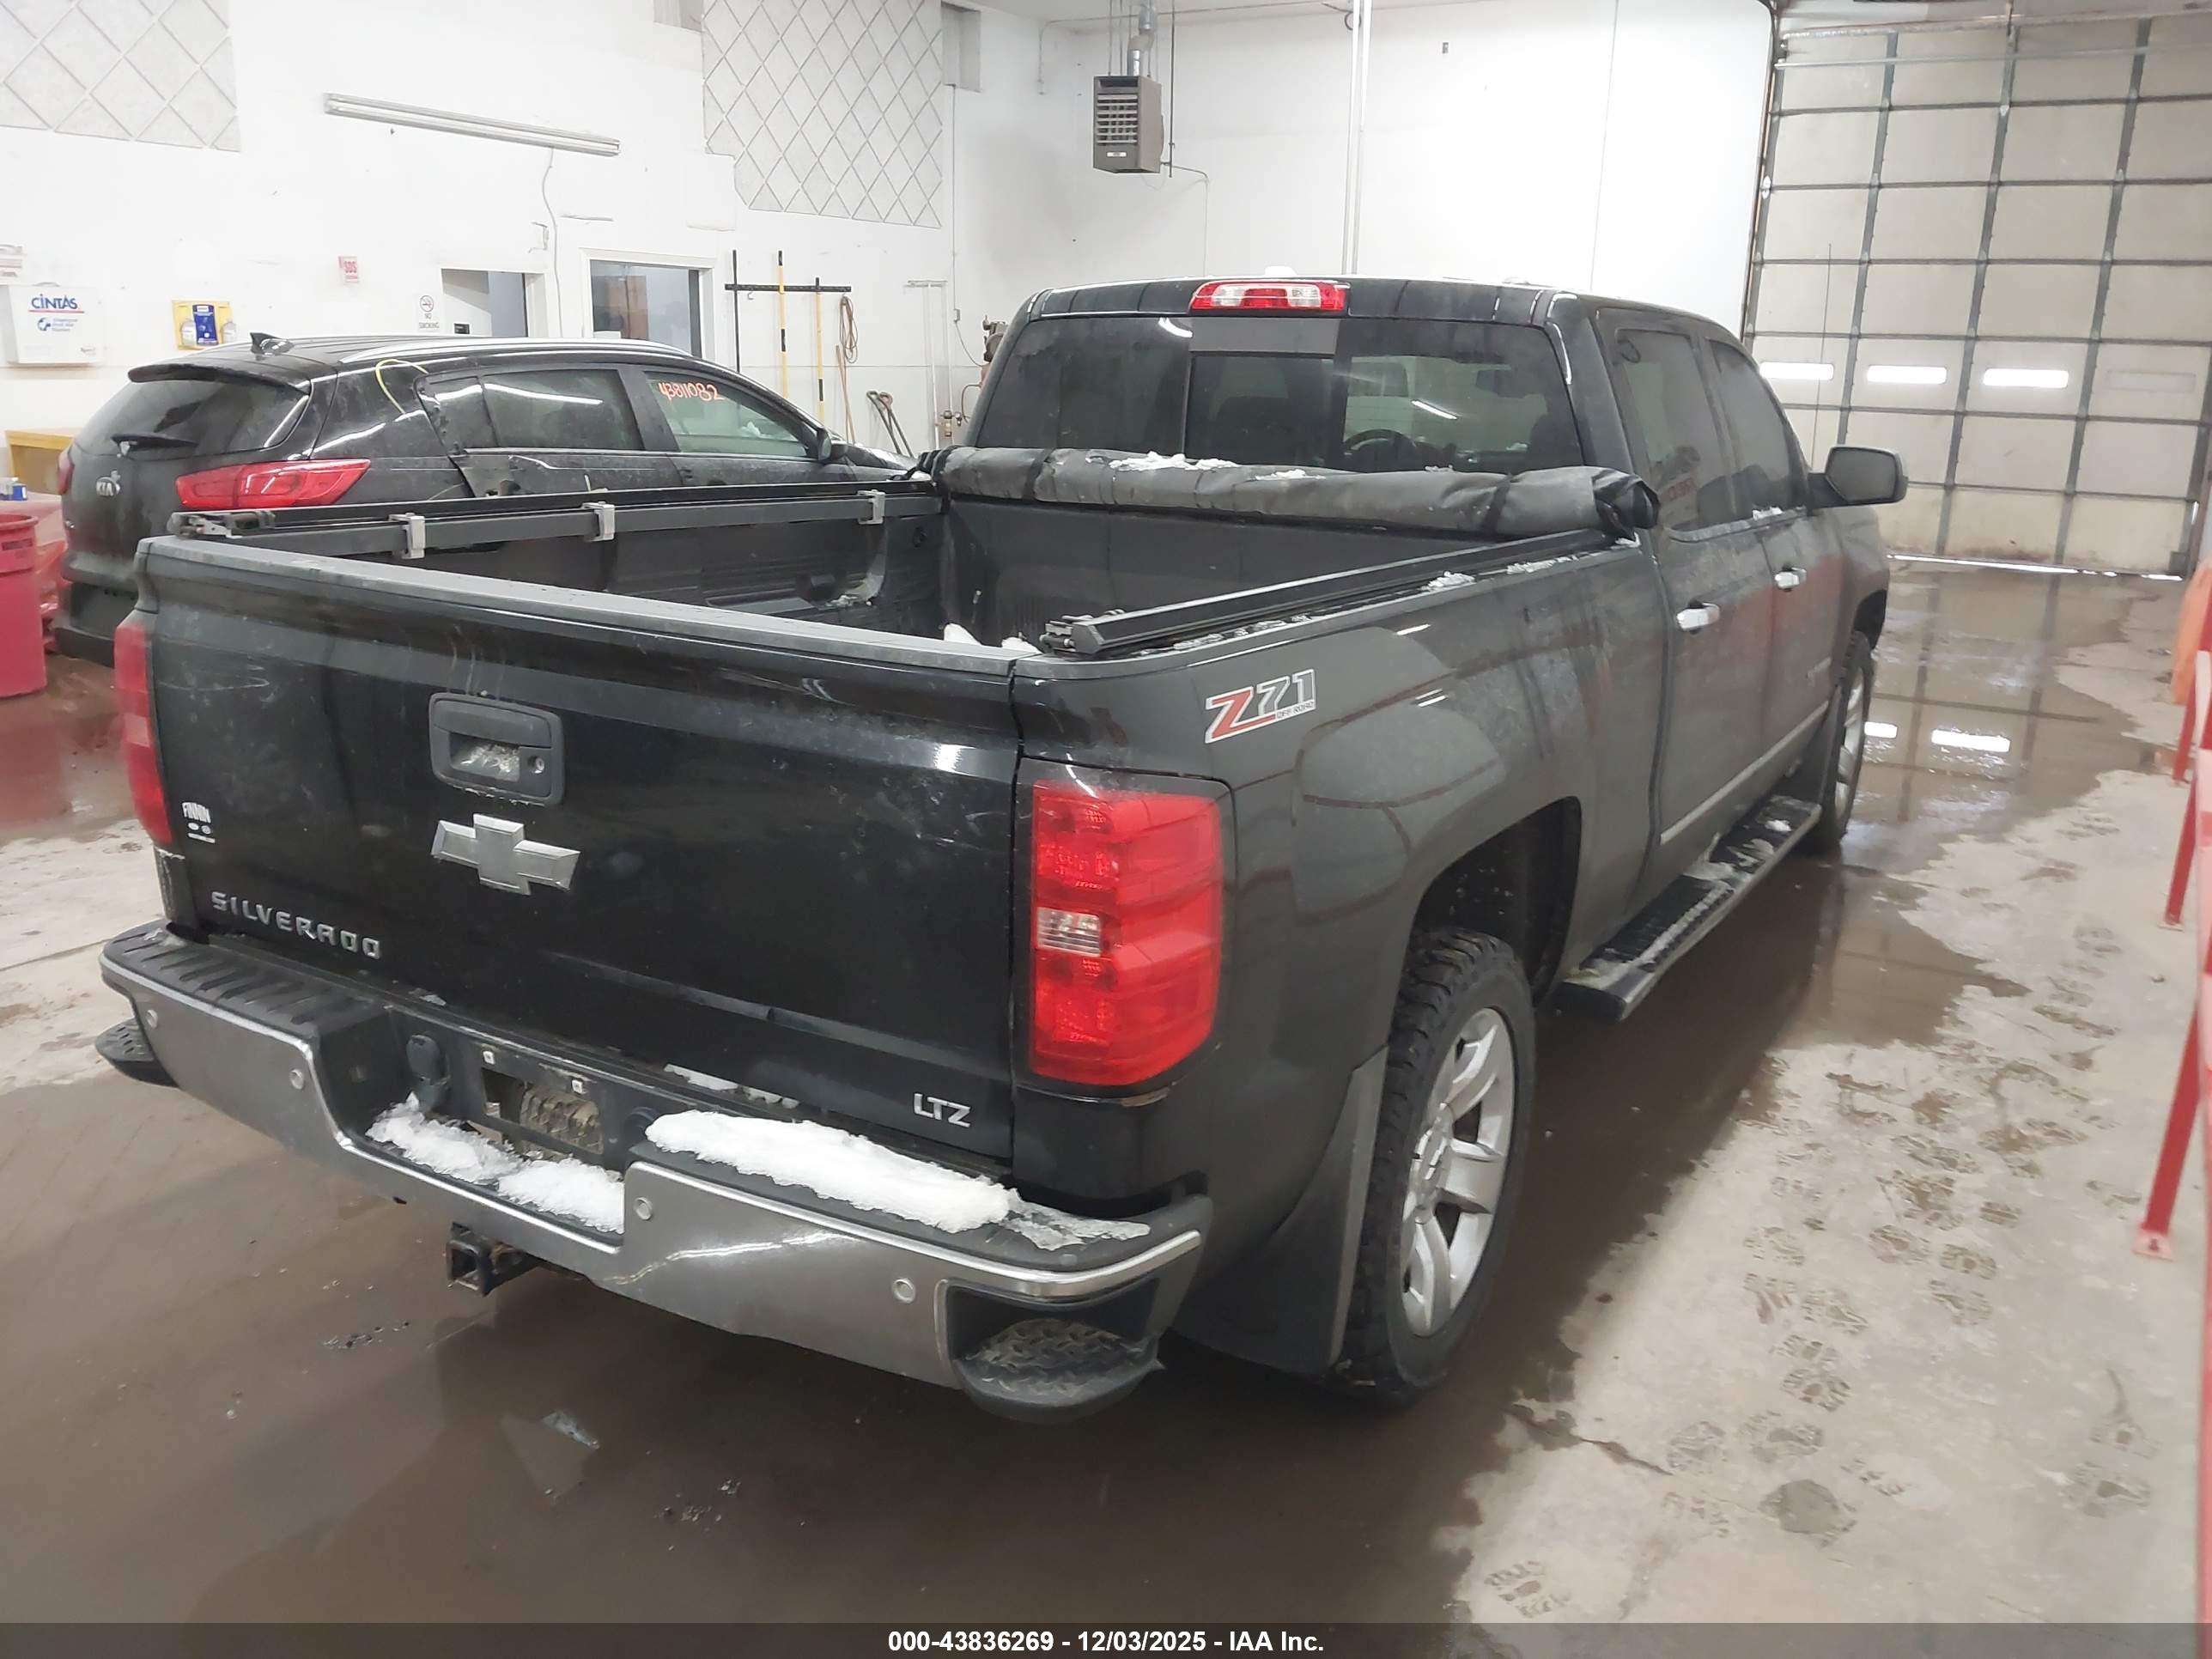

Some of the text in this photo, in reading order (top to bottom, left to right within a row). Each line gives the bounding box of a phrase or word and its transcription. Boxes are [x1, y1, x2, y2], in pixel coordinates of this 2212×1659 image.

[658, 382, 726, 401] 43811082
[96, 478, 115, 496] KIA
[1205, 669, 1316, 744] Z71
[211, 890, 380, 959] SILVERADO
[914, 1093, 970, 1127] LTZ
